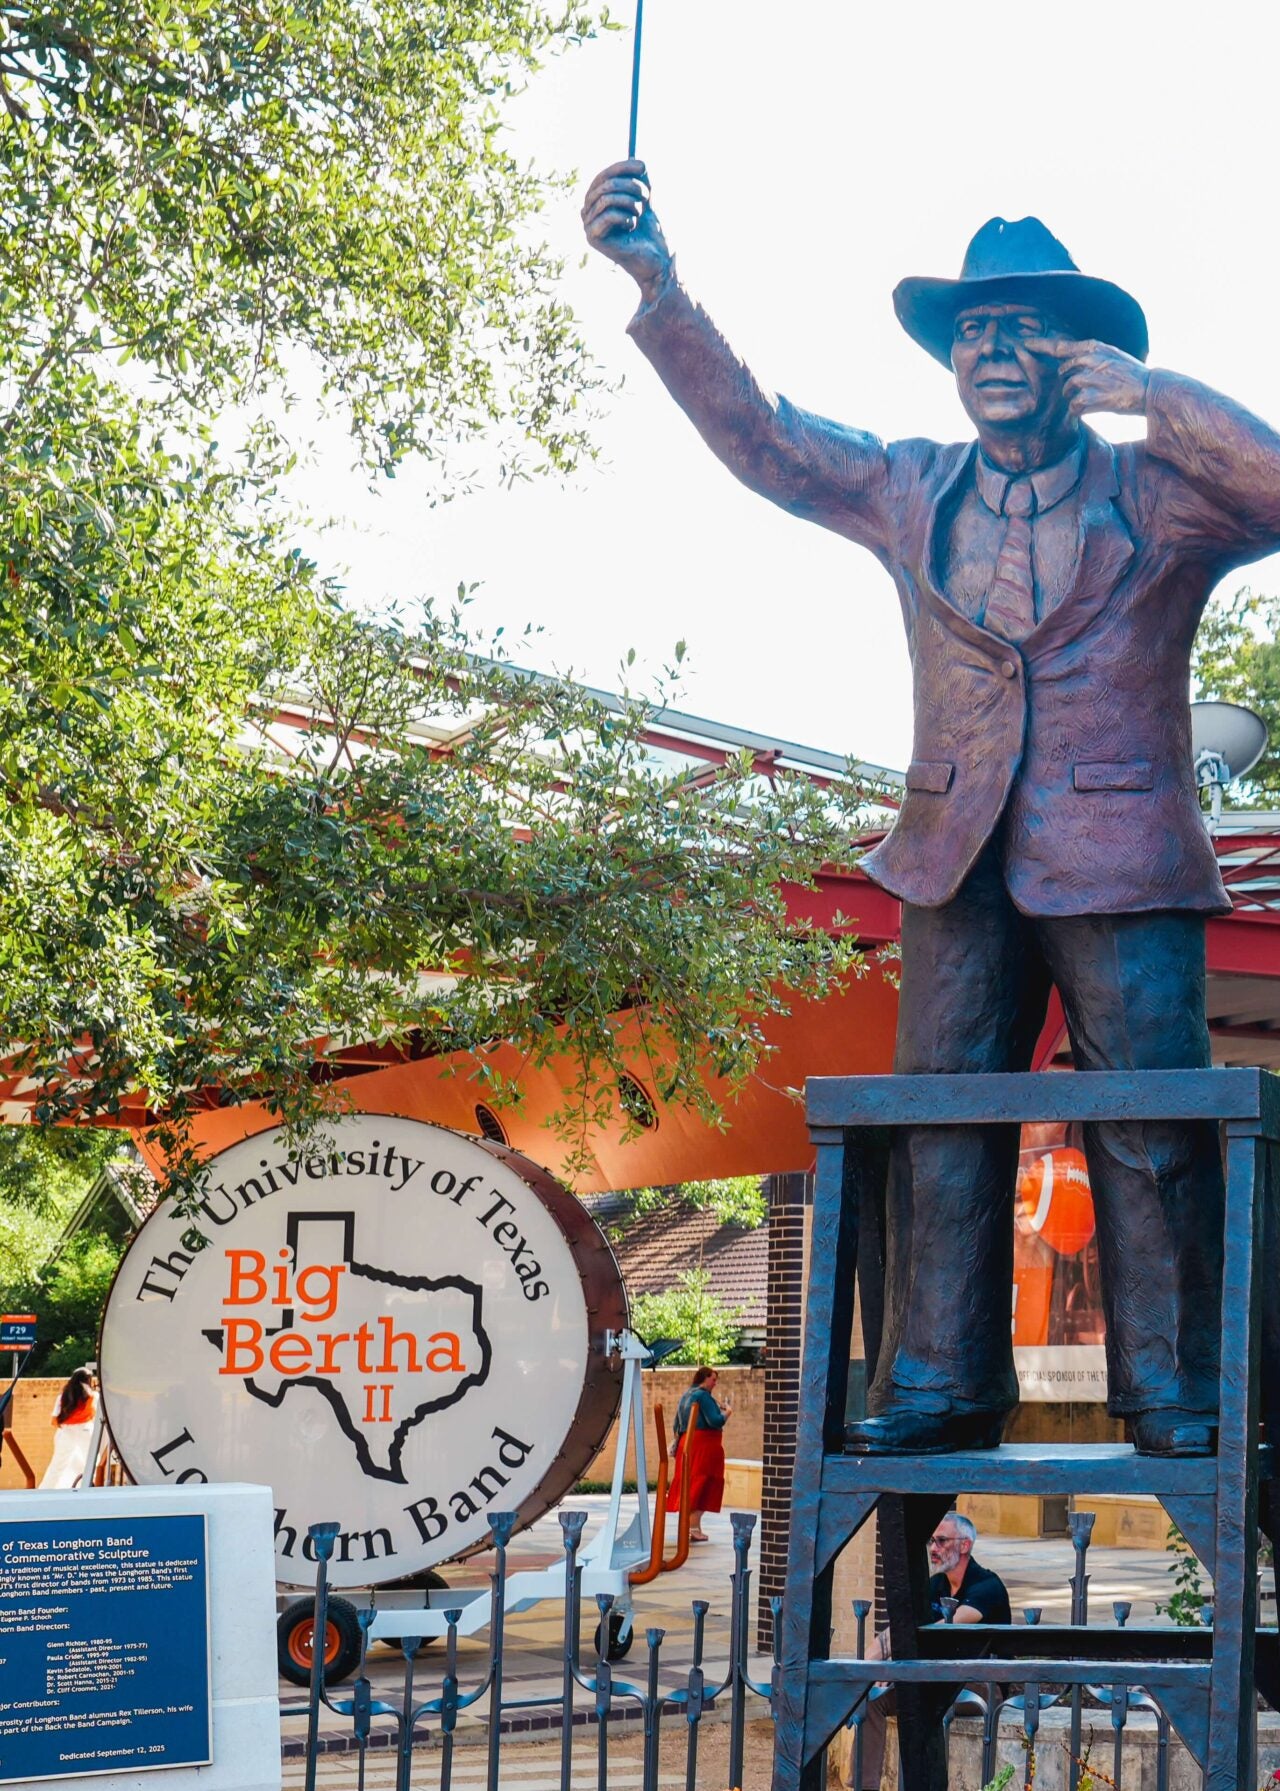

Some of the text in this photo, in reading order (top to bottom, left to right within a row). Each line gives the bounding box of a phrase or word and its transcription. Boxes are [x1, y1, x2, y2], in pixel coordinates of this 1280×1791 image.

[136, 1140, 549, 1302] The University of Texas
[222, 1248, 346, 1322] Big
[10, 1326, 27, 1335] F29
[218, 1316, 466, 1375] Bertha
[1018, 1370, 1046, 1382] OFFCIAL
[1047, 1370, 1076, 1382] SPONSOR
[1077, 1370, 1085, 1382] OF
[1086, 1370, 1100, 1382] THE
[362, 1384, 394, 1422] II
[403, 1426, 535, 1545] Band
[2, 1536, 133, 1551] of Texas Longhorn Band
[4, 1549, 149, 1564] Commemorative Sculpture
[80, 1563, 119, 1571] excellence,
[118, 1568, 150, 1577] Longhorn
[137, 1575, 155, 1583] 1985.
[89, 1586, 107, 1594] past,
[151, 1582, 173, 1590] future.
[38, 1606, 68, 1614] Founder:
[36, 1623, 70, 1631] Directors:
[13, 1700, 60, 1709] Contributors:
[34, 1715, 67, 1724] Longhorn
[69, 1713, 86, 1721] Band
[178, 1704, 193, 1712] wife
[3, 1727, 19, 1735] part
[21, 1725, 29, 1733] of
[31, 1724, 43, 1732] the
[45, 1723, 62, 1731] Back
[96, 1718, 132, 1726] Campaign.
[59, 1744, 165, 1761] Dedicated September 12, 2025
